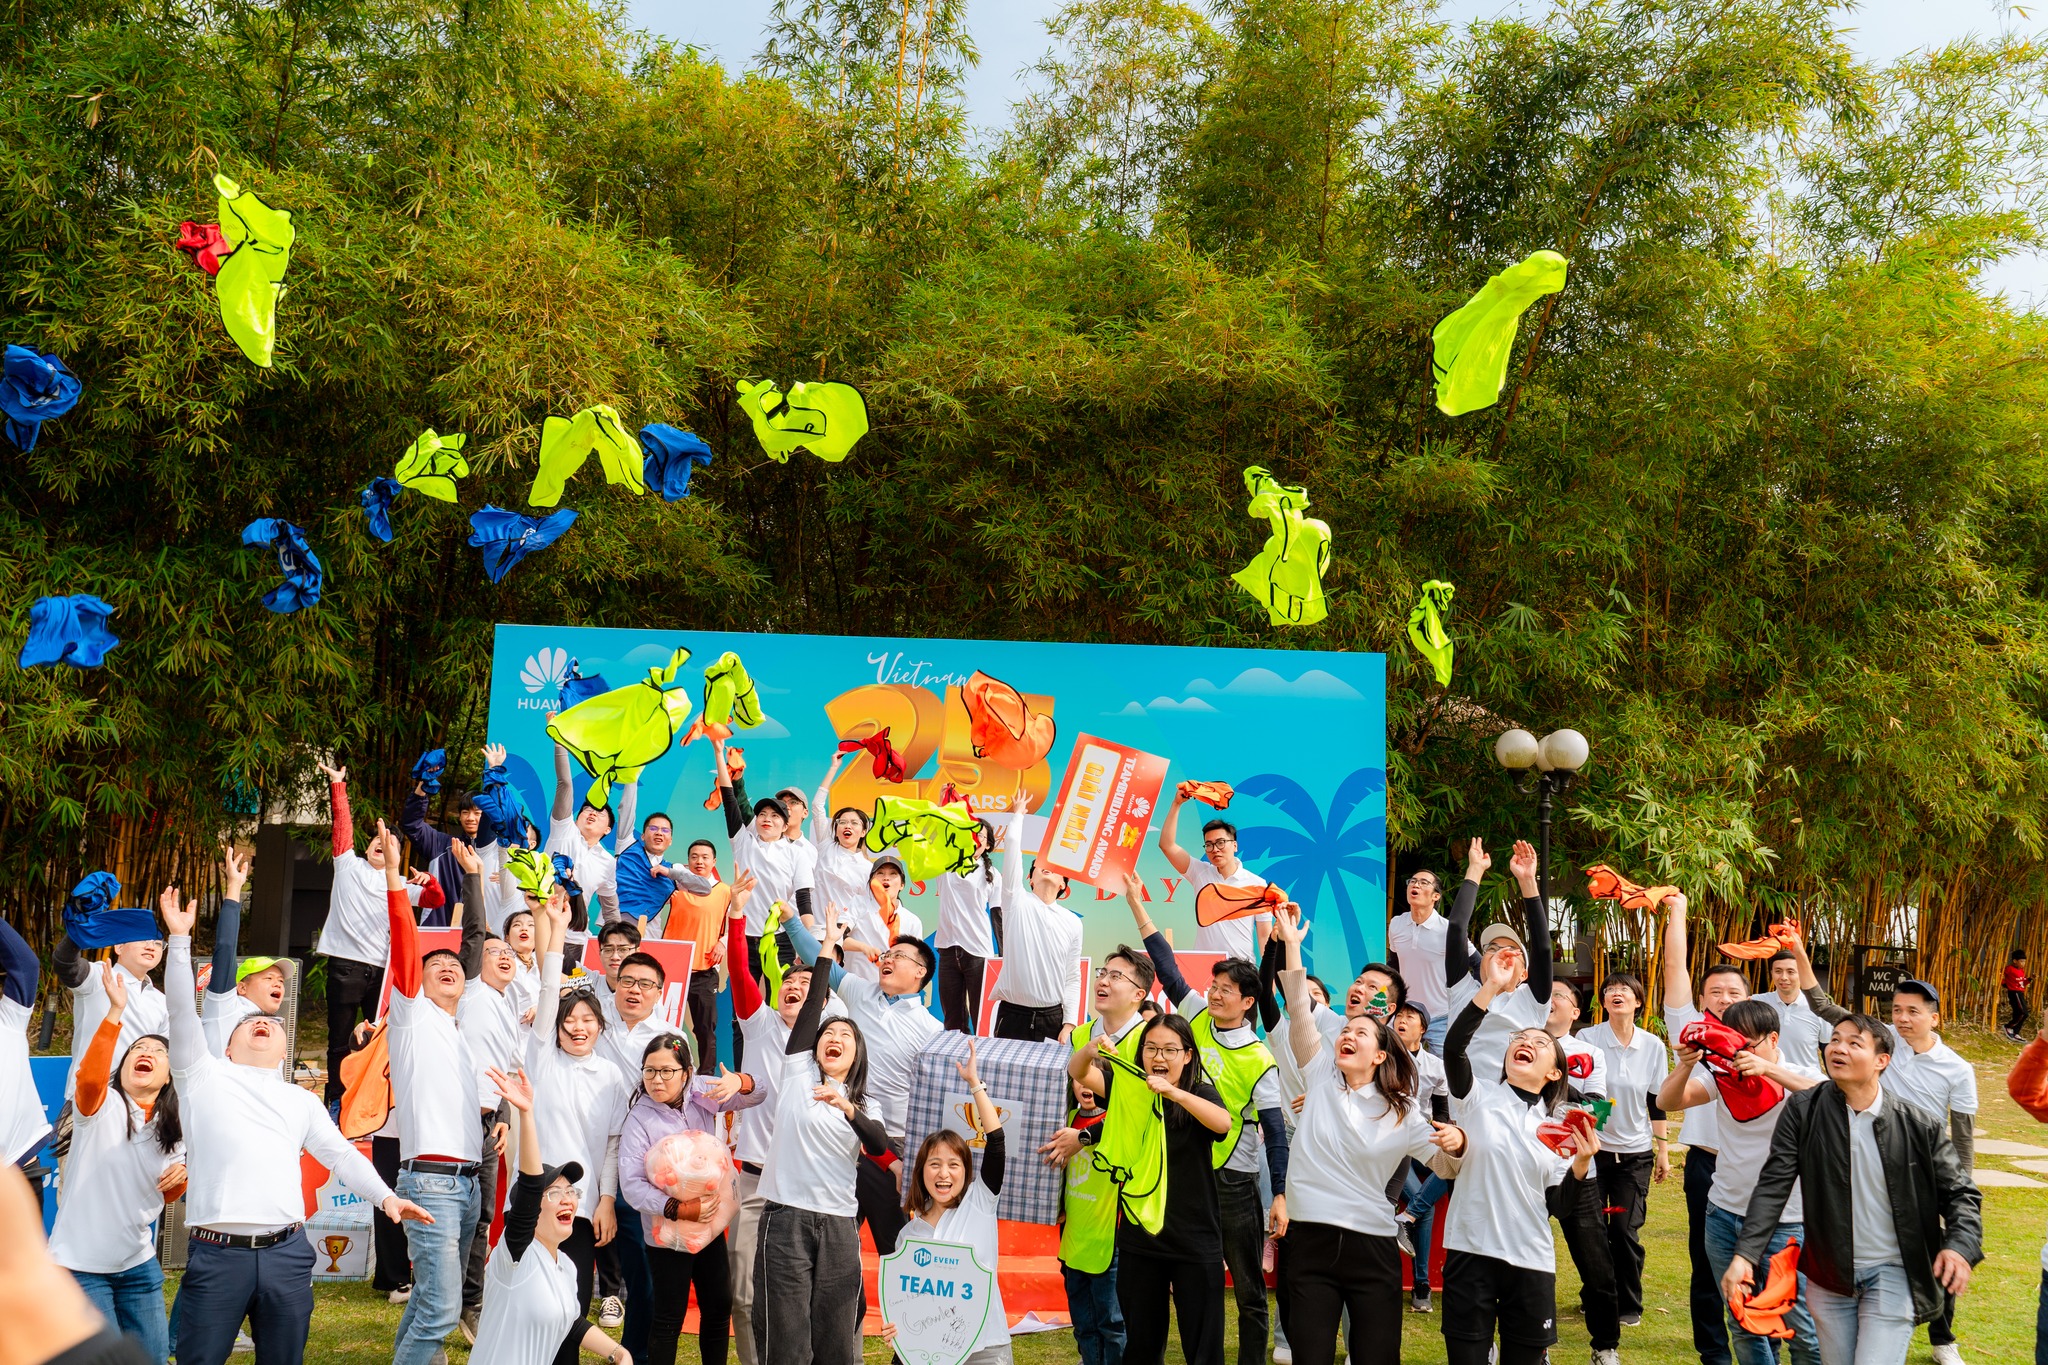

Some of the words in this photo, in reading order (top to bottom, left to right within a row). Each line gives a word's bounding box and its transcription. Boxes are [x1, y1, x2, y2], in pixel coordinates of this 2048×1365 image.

[517, 698, 561, 710] HUAW
[968, 794, 1007, 810] ARS
[1088, 837, 1109, 879] AWARD
[1873, 971, 1891, 980] WC
[1868, 982, 1895, 992] NAM
[332, 1245, 339, 1255] 3
[933, 1256, 960, 1265] EVENT
[899, 1275, 954, 1298] TEAM
[961, 1283, 973, 1300] 3
